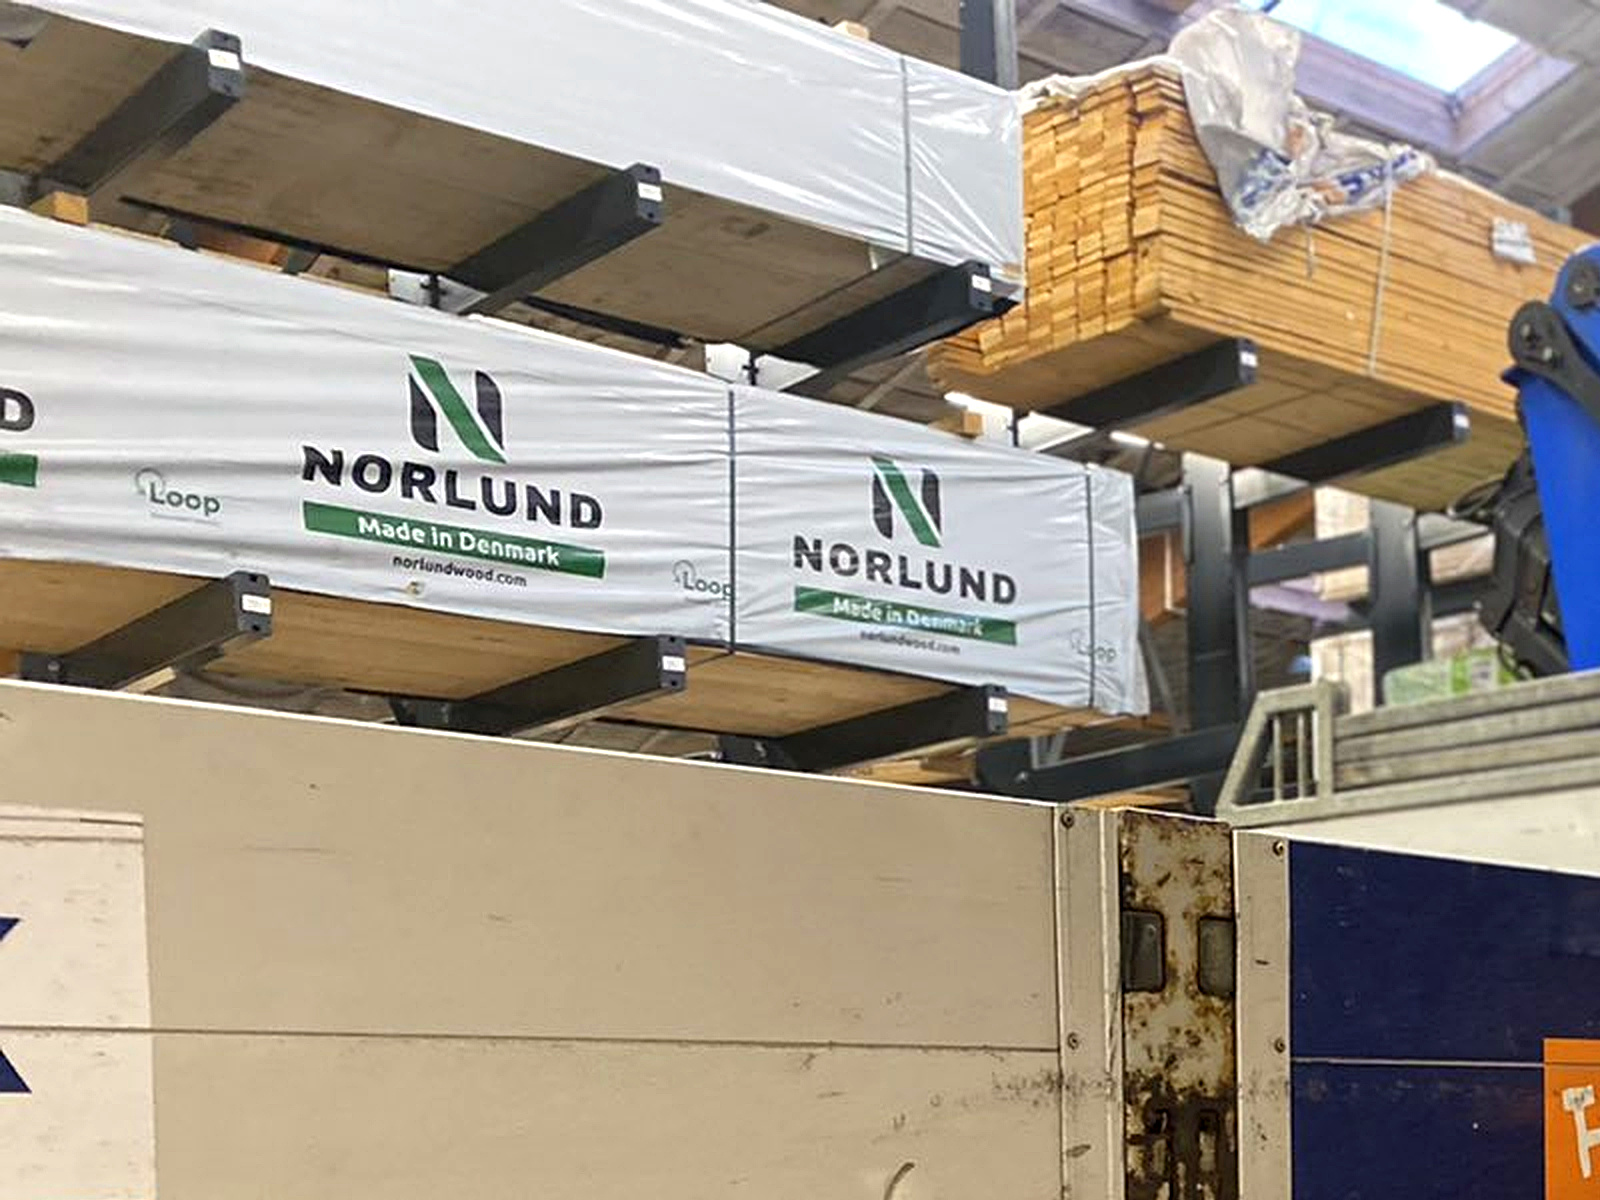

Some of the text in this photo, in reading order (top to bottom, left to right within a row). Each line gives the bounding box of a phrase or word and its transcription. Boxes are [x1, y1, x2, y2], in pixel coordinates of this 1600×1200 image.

[149, 482, 221, 516] Loop
[302, 446, 603, 529] NORLUND
[357, 516, 560, 567] Made in Denmark
[392, 555, 528, 588] norlundwood.com
[793, 534, 1017, 605] NORLUND
[832, 597, 984, 637] Made in Denmark
